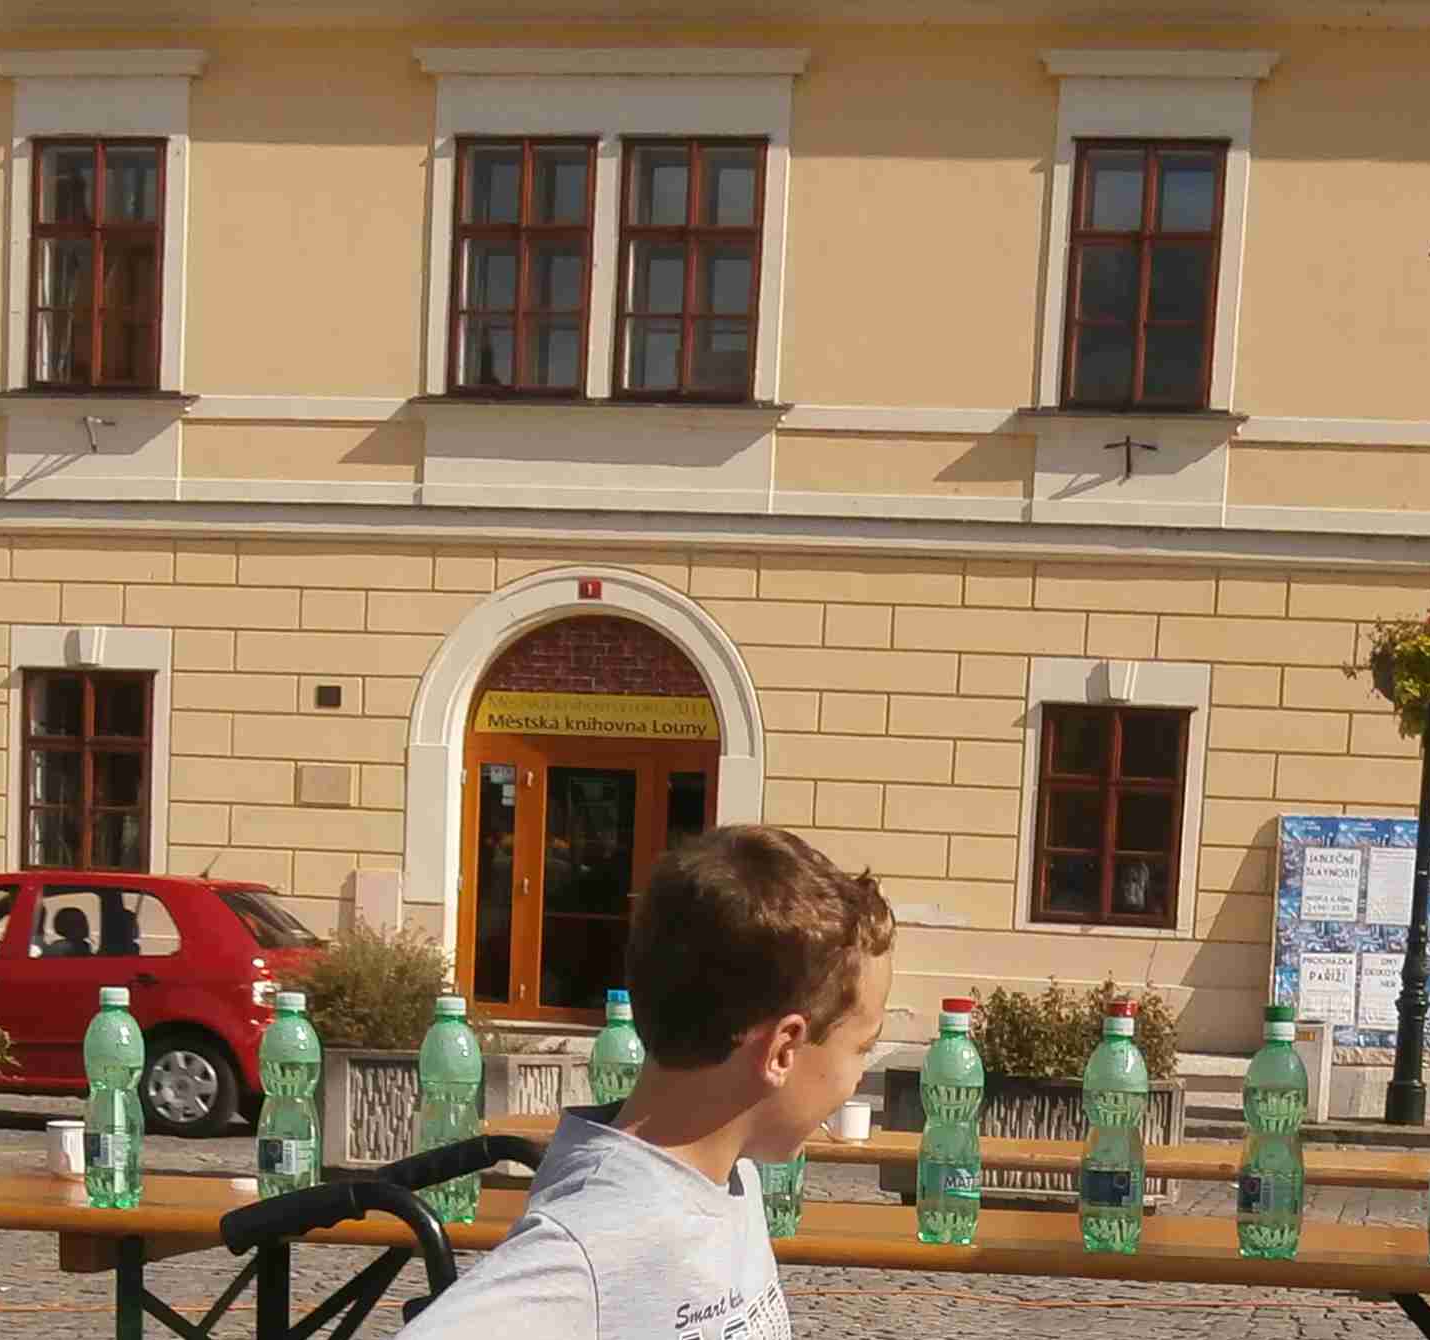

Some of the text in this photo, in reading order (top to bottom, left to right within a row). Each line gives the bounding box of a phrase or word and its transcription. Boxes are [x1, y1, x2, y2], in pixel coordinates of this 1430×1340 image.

[487, 713, 707, 736] Městská knihovna Louny
[674, 1296, 726, 1329] Smart
